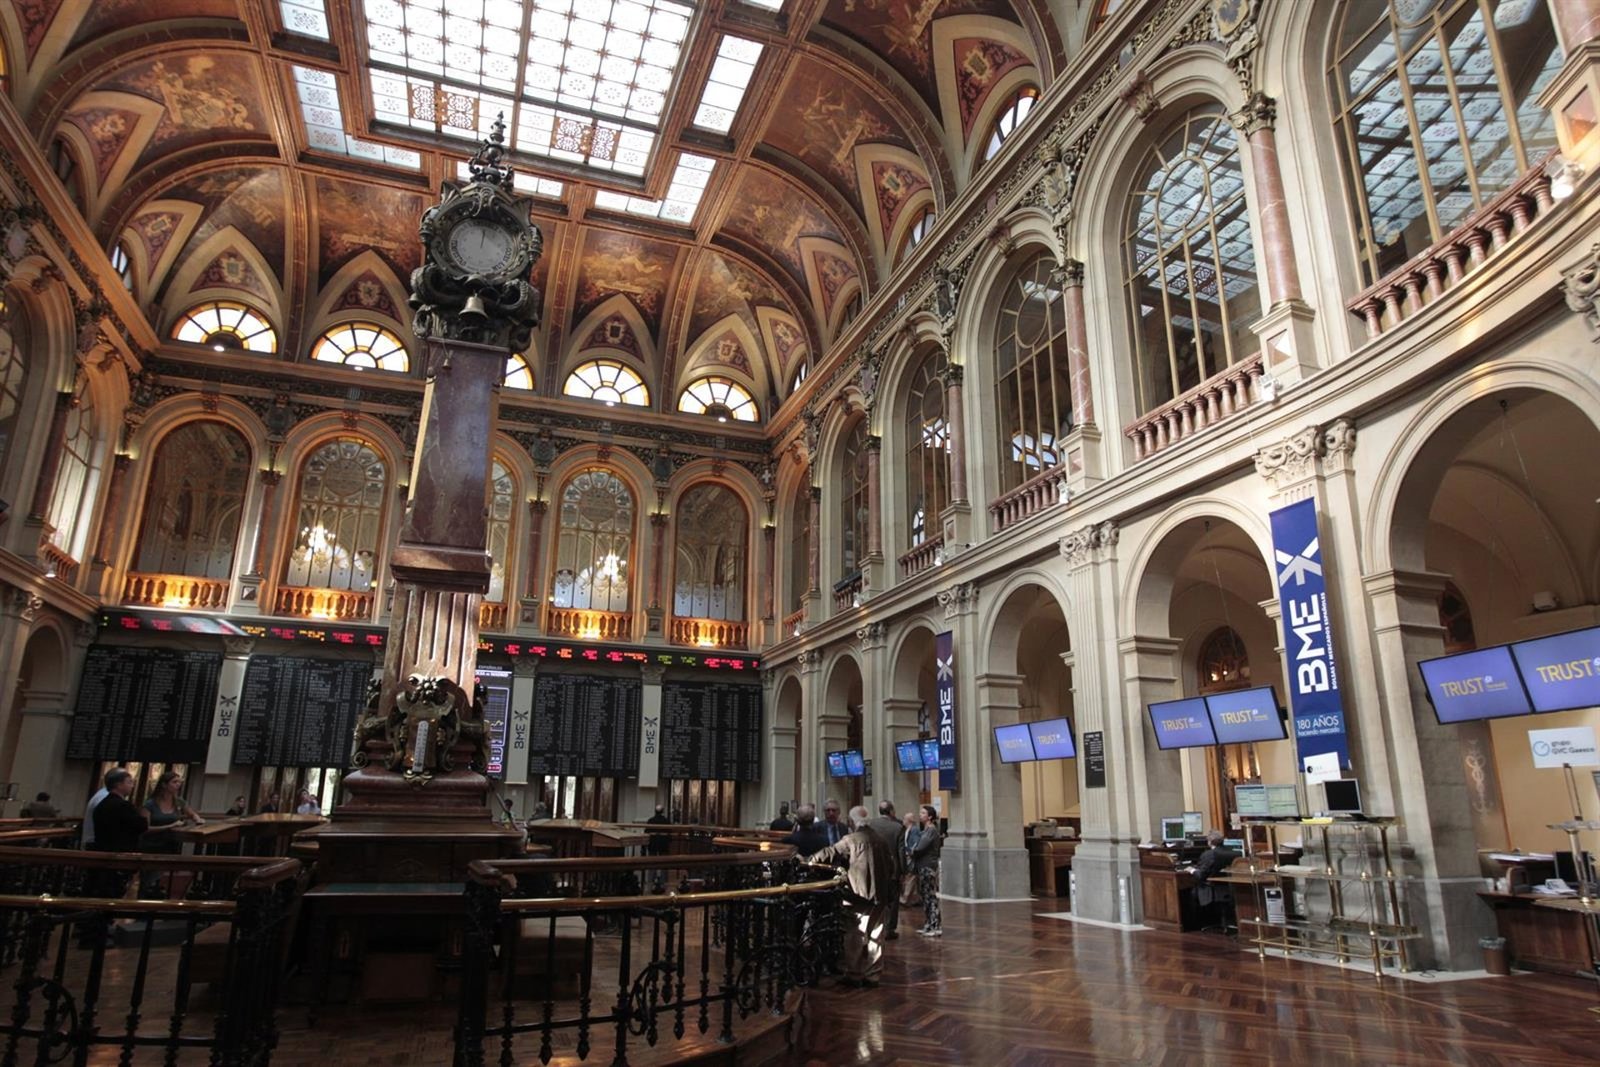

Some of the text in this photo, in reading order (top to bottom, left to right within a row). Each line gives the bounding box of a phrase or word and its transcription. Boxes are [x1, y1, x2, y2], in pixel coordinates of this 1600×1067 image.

[1320, 592, 1328, 625] ESPAÑOLES
[1289, 593, 1330, 694] BME
[1324, 626, 1334, 660] MERCADOS
[1536, 658, 1593, 683] TRUST
[1440, 676, 1484, 698] TRUST
[217, 709, 233, 737] BME
[940, 687, 952, 746] BME
[1161, 718, 1189, 732] TRUST
[1220, 710, 1252, 725] TRUST
[1296, 715, 1339, 730] 180 AÑOS
[514, 724, 526, 749] BME
[645, 730, 655, 754] BME
[1037, 734, 1056, 745] TRUST
